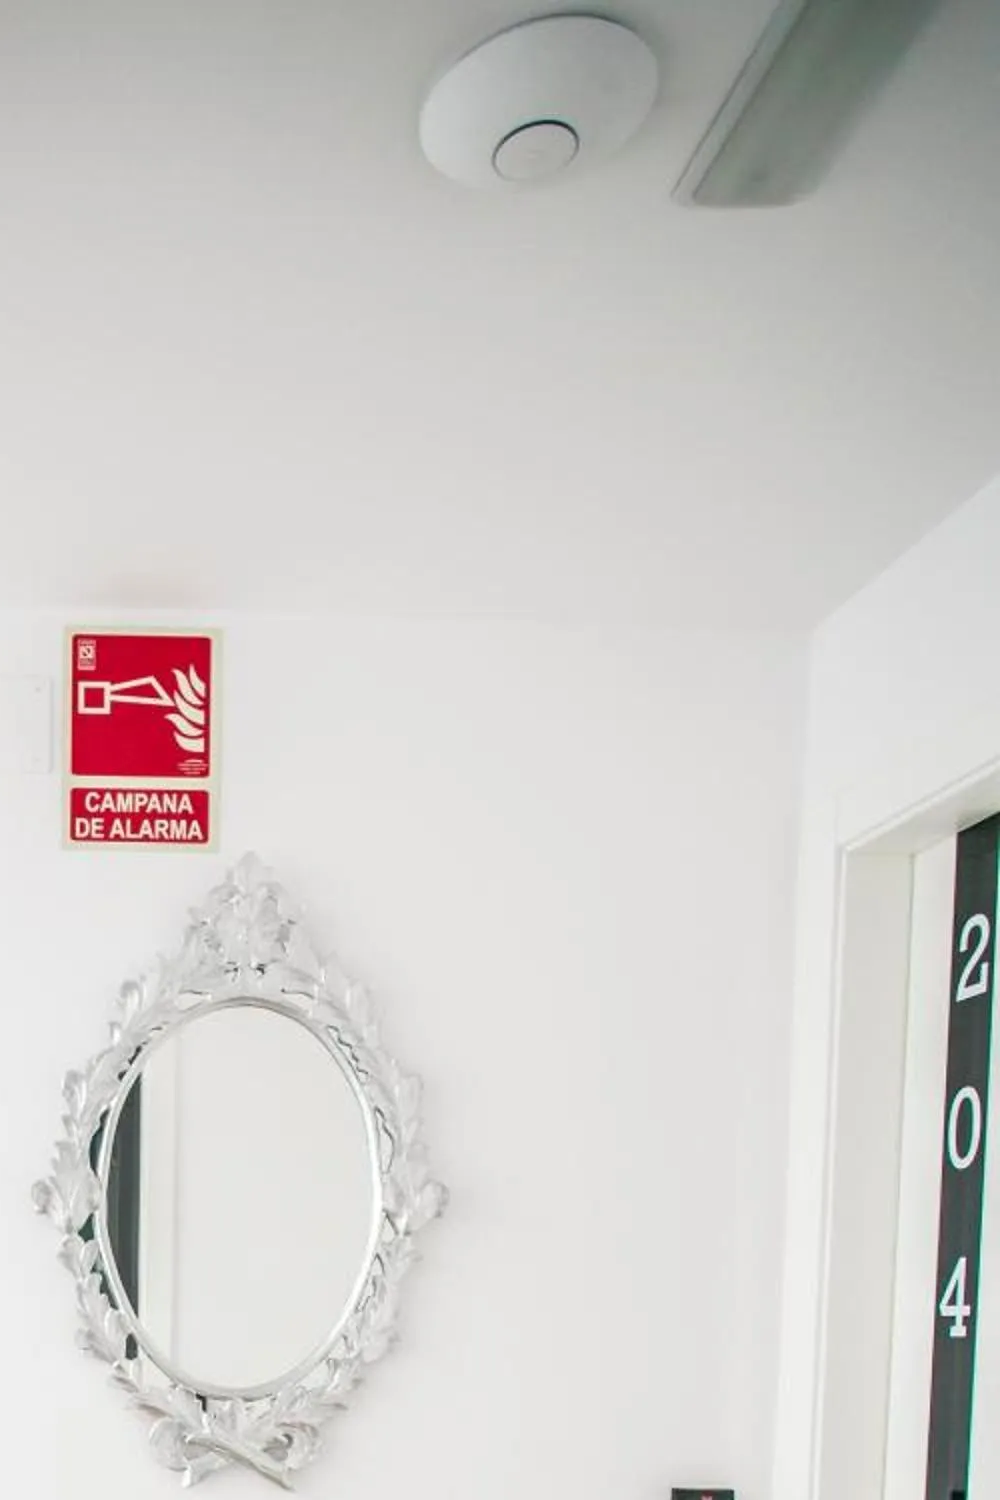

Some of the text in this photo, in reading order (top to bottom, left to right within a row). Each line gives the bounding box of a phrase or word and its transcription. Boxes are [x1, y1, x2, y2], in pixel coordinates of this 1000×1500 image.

[85, 791, 194, 814] CAMPANA
[75, 817, 204, 840] DE ALARMA
